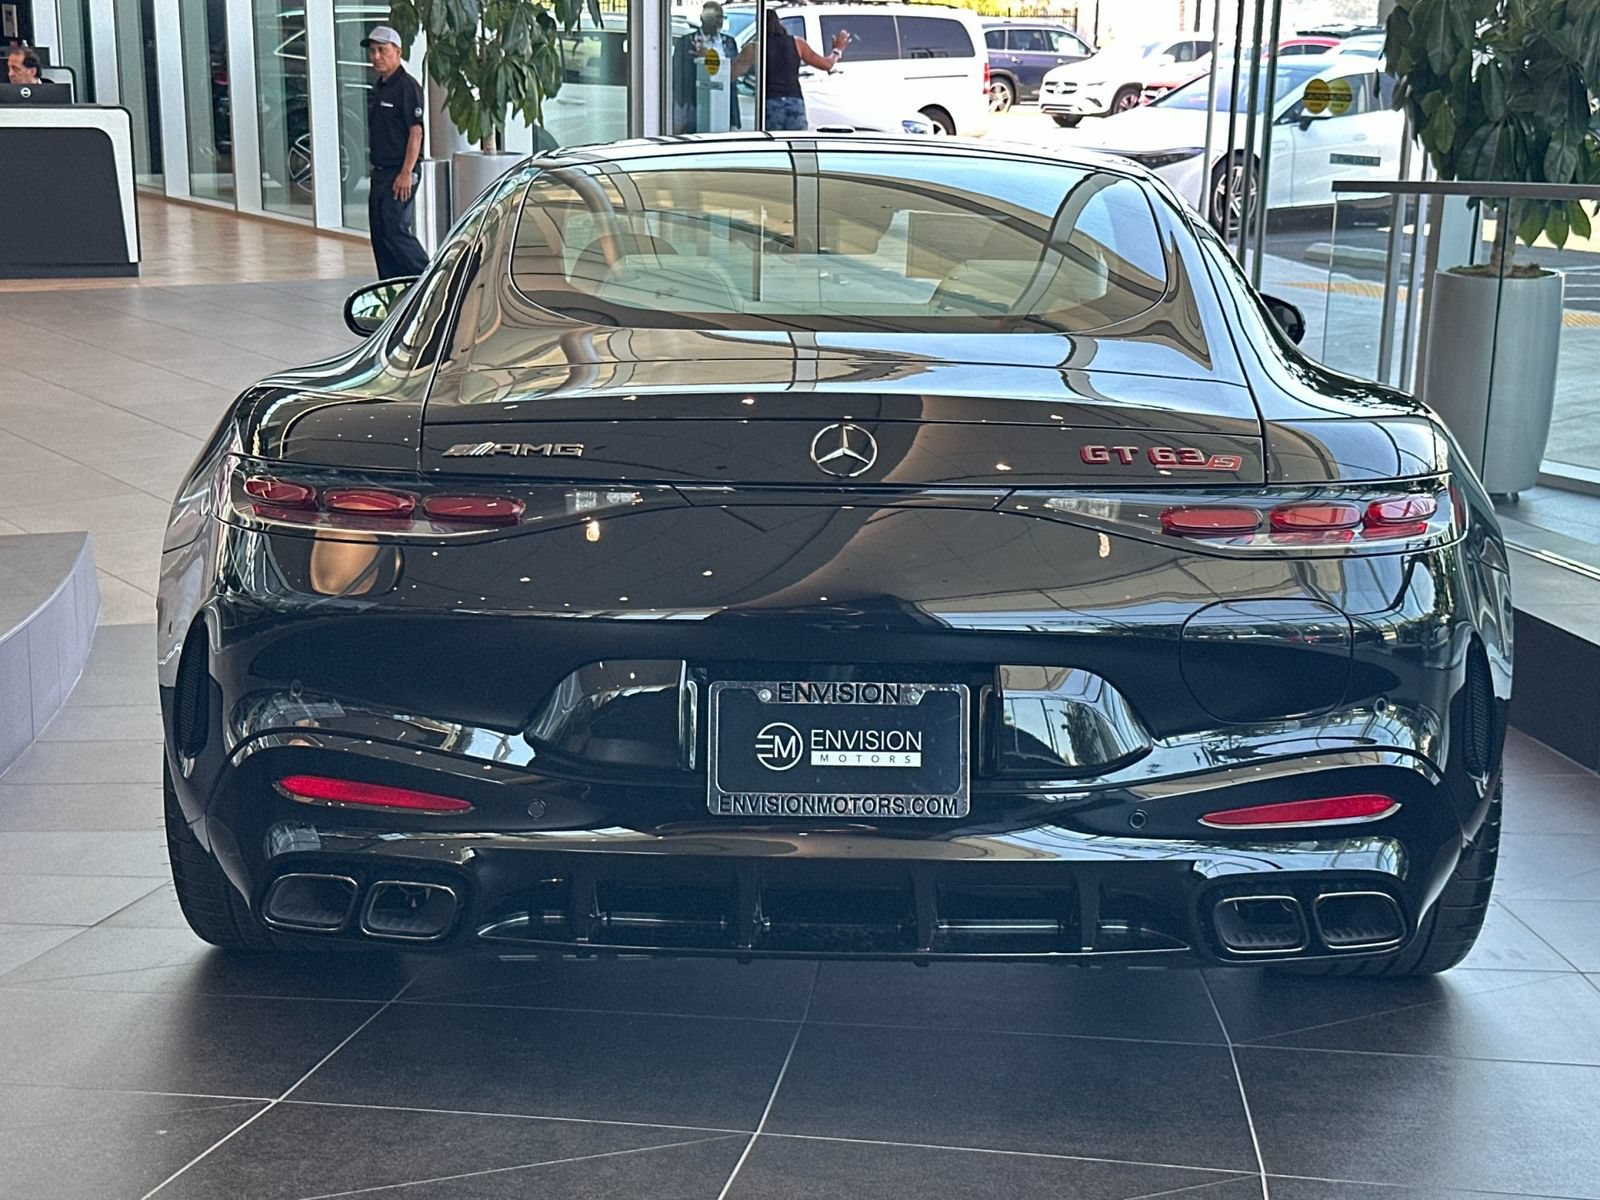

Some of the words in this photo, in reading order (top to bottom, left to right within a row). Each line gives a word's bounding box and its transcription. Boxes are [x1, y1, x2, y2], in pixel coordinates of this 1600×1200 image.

[486, 442, 585, 457] AMG
[1080, 445, 1139, 465] GT
[778, 682, 901, 704] ENVISION
[810, 729, 922, 751] ENVISION
[819, 753, 912, 764] MOTORS
[718, 794, 958, 815] ENVISIONMOTORS.COM
